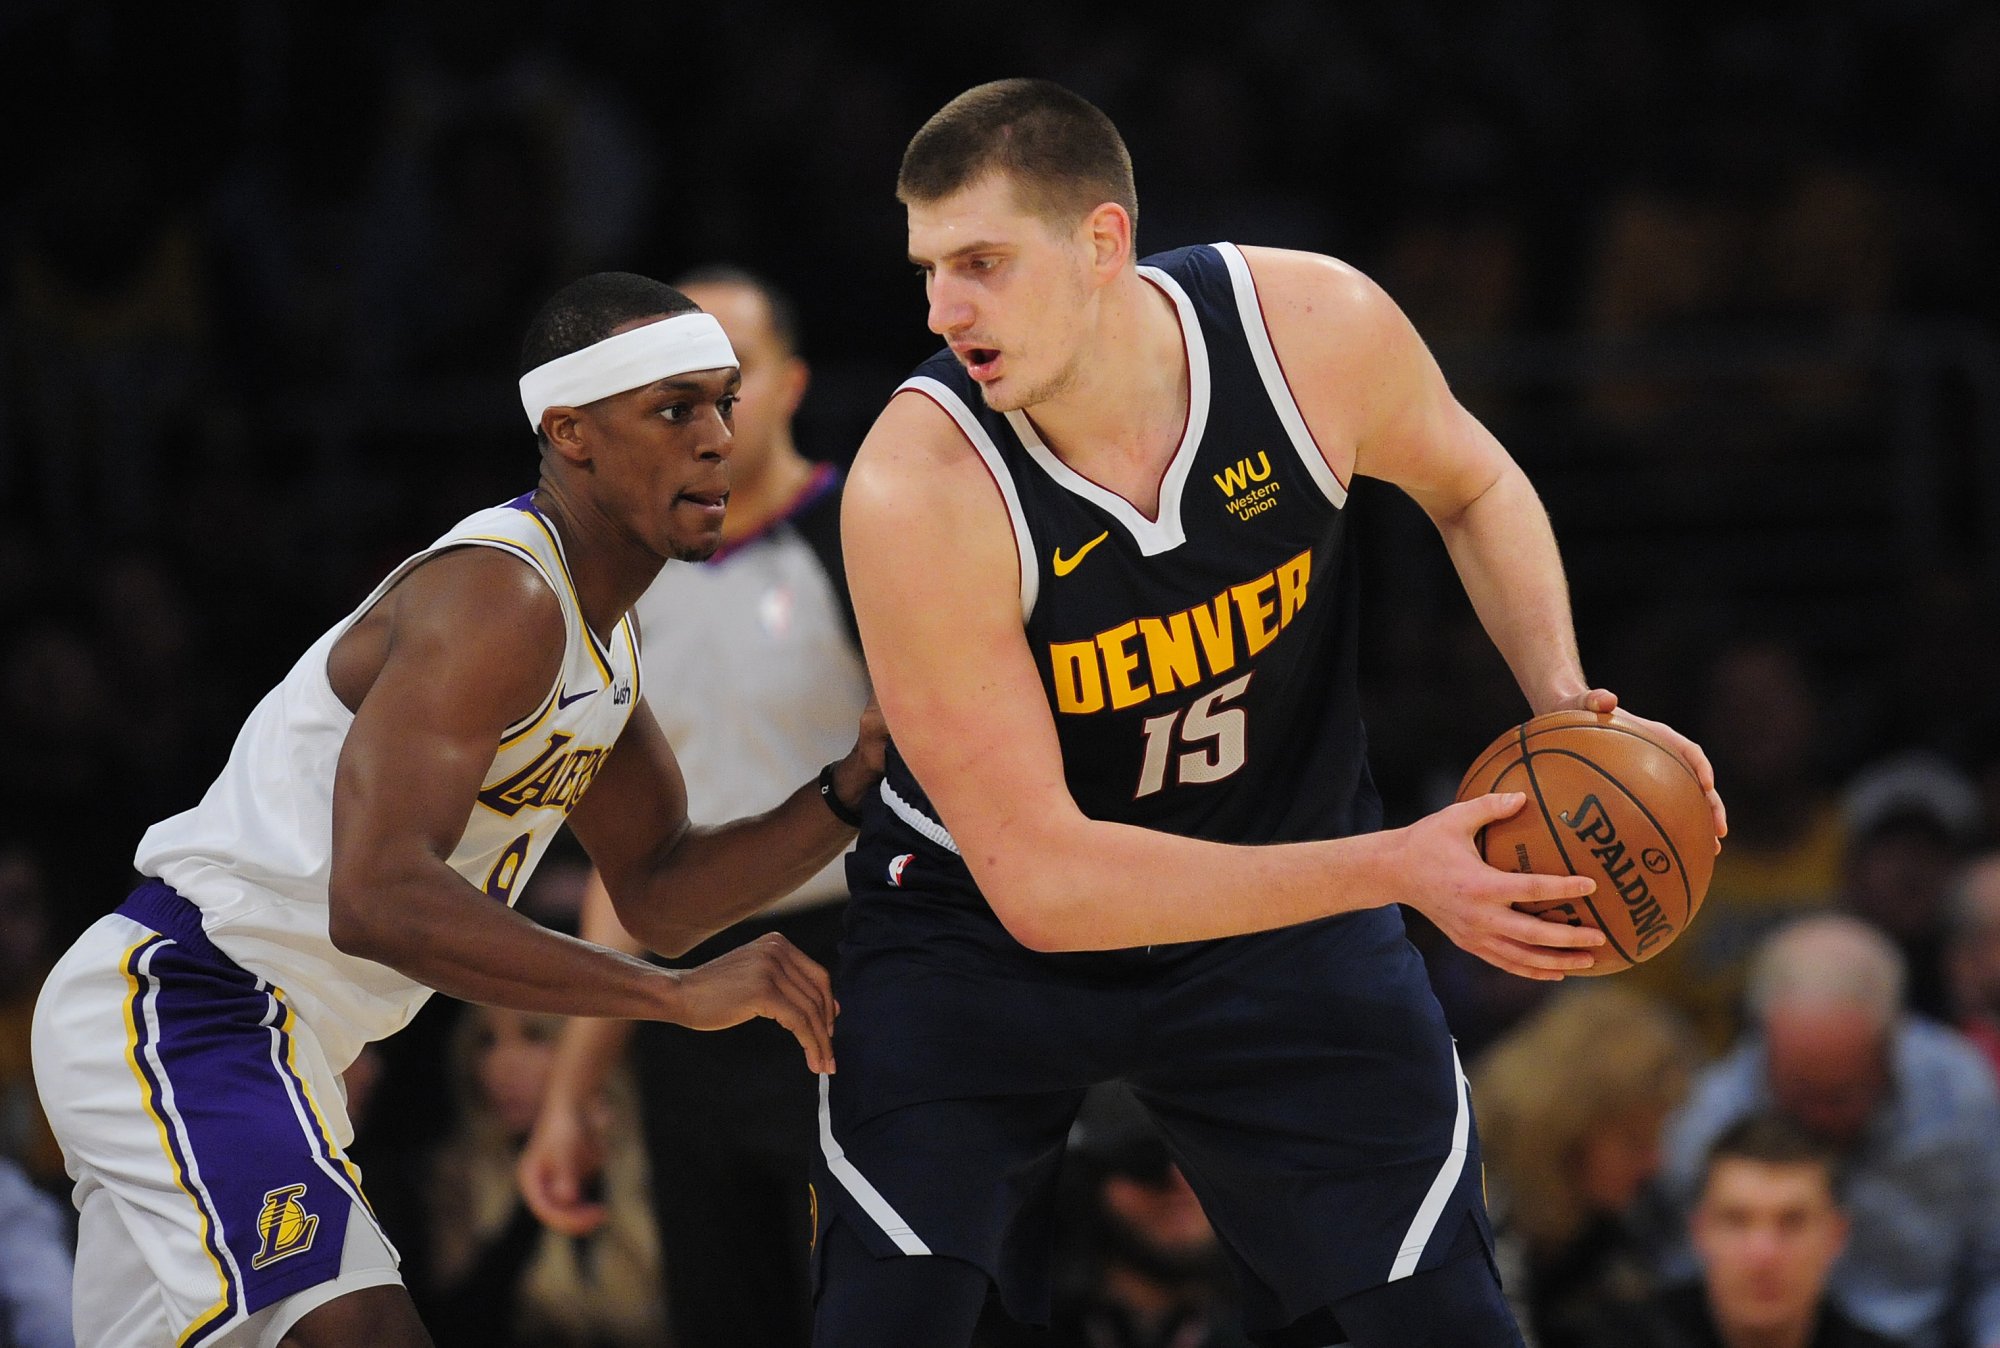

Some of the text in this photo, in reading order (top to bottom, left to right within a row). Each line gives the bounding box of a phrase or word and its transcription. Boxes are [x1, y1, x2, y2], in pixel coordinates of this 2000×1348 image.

[1213, 450, 1271, 498] WU
[1225, 481, 1280, 514] Western
[1239, 497, 1277, 521] Union
[1049, 547, 1312, 714] DENVER
[1133, 669, 1256, 801] 15
[1558, 793, 1674, 957] SPALDING
